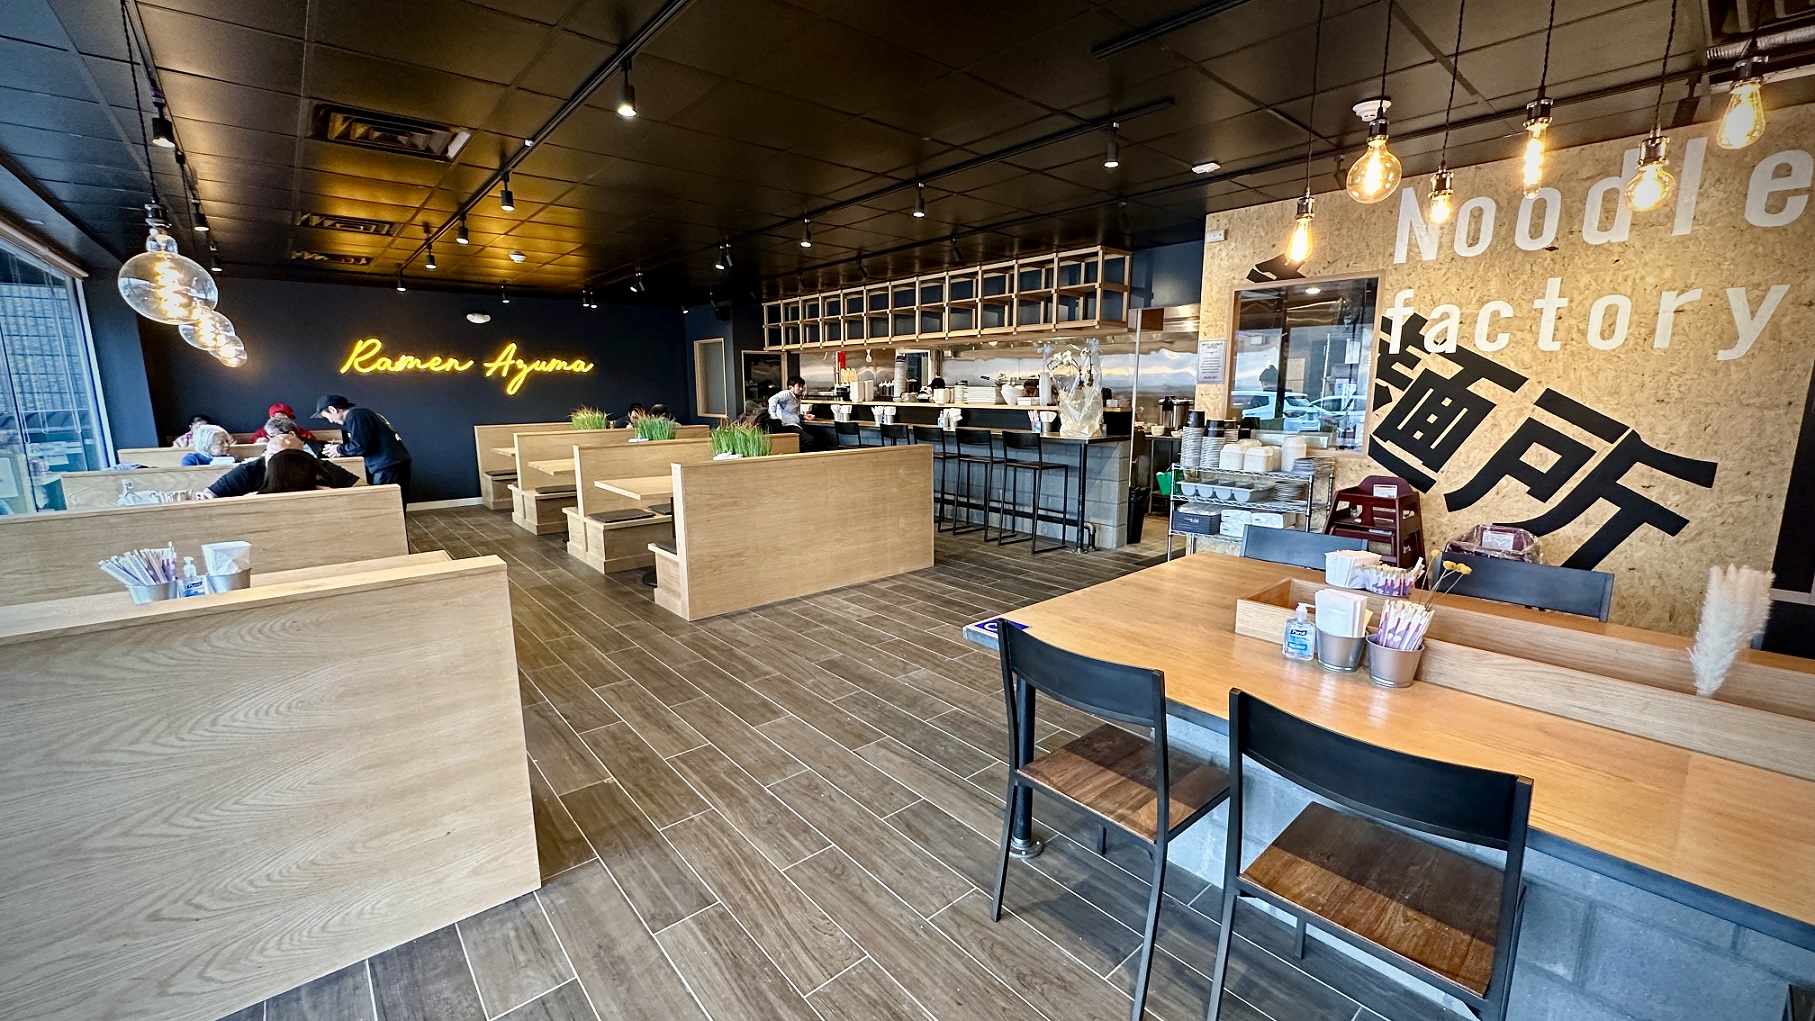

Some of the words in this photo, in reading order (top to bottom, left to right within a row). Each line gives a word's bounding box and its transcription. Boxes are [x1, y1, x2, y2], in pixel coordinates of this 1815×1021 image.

[1393, 136, 1814, 264] Noodle
[340, 338, 474, 374] Ramen
[484, 342, 594, 395] Azuma
[1385, 276, 1791, 362] factory
[1246, 253, 1718, 572] 麺所
